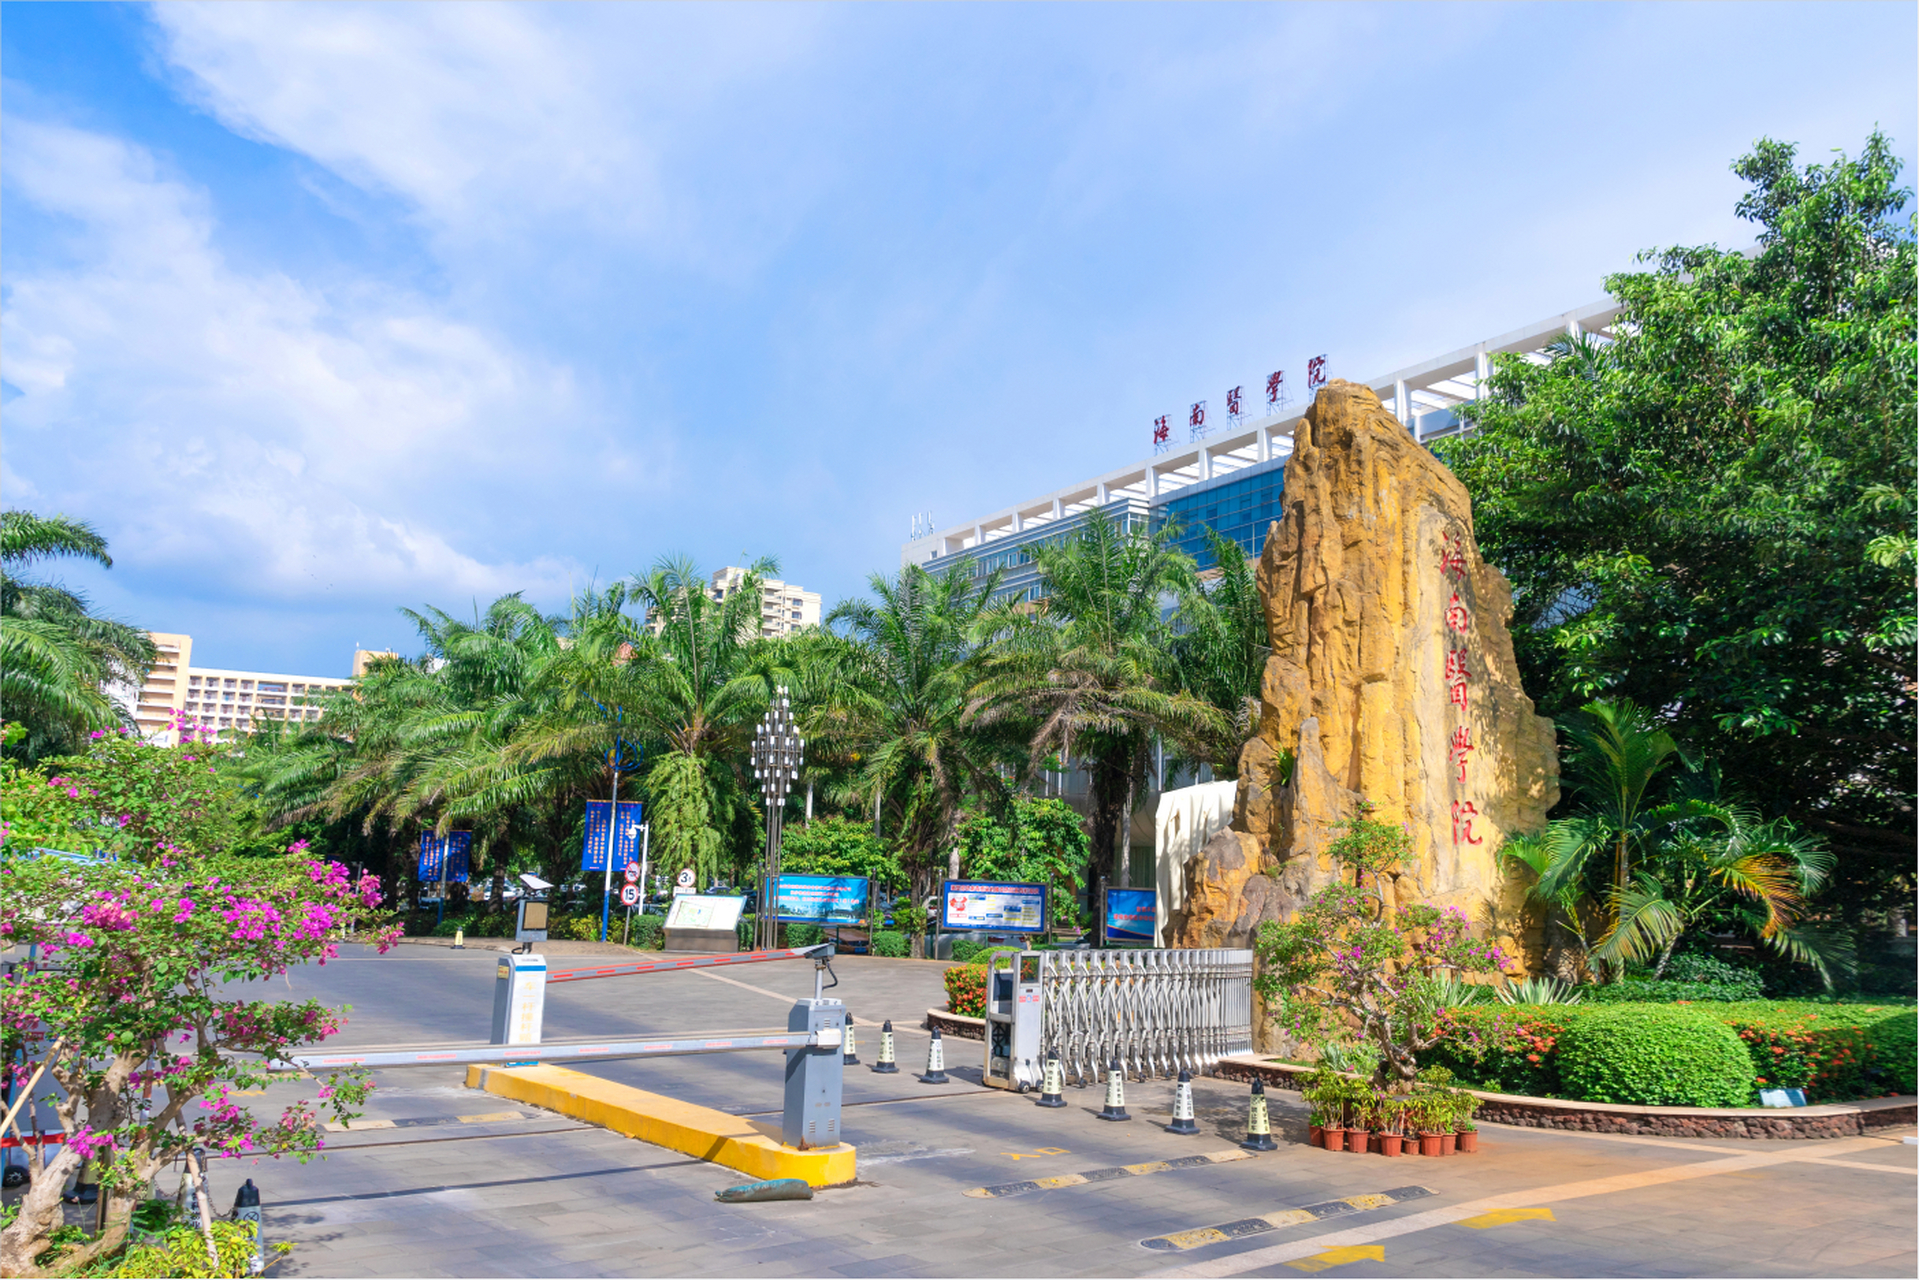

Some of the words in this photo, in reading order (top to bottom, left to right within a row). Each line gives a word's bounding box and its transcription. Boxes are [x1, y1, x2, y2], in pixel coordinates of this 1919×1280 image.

[1153, 355, 1327, 445] 海南醫學院
[1439, 530, 1483, 846] 海南醫學院
[624, 888, 635, 901] 15
